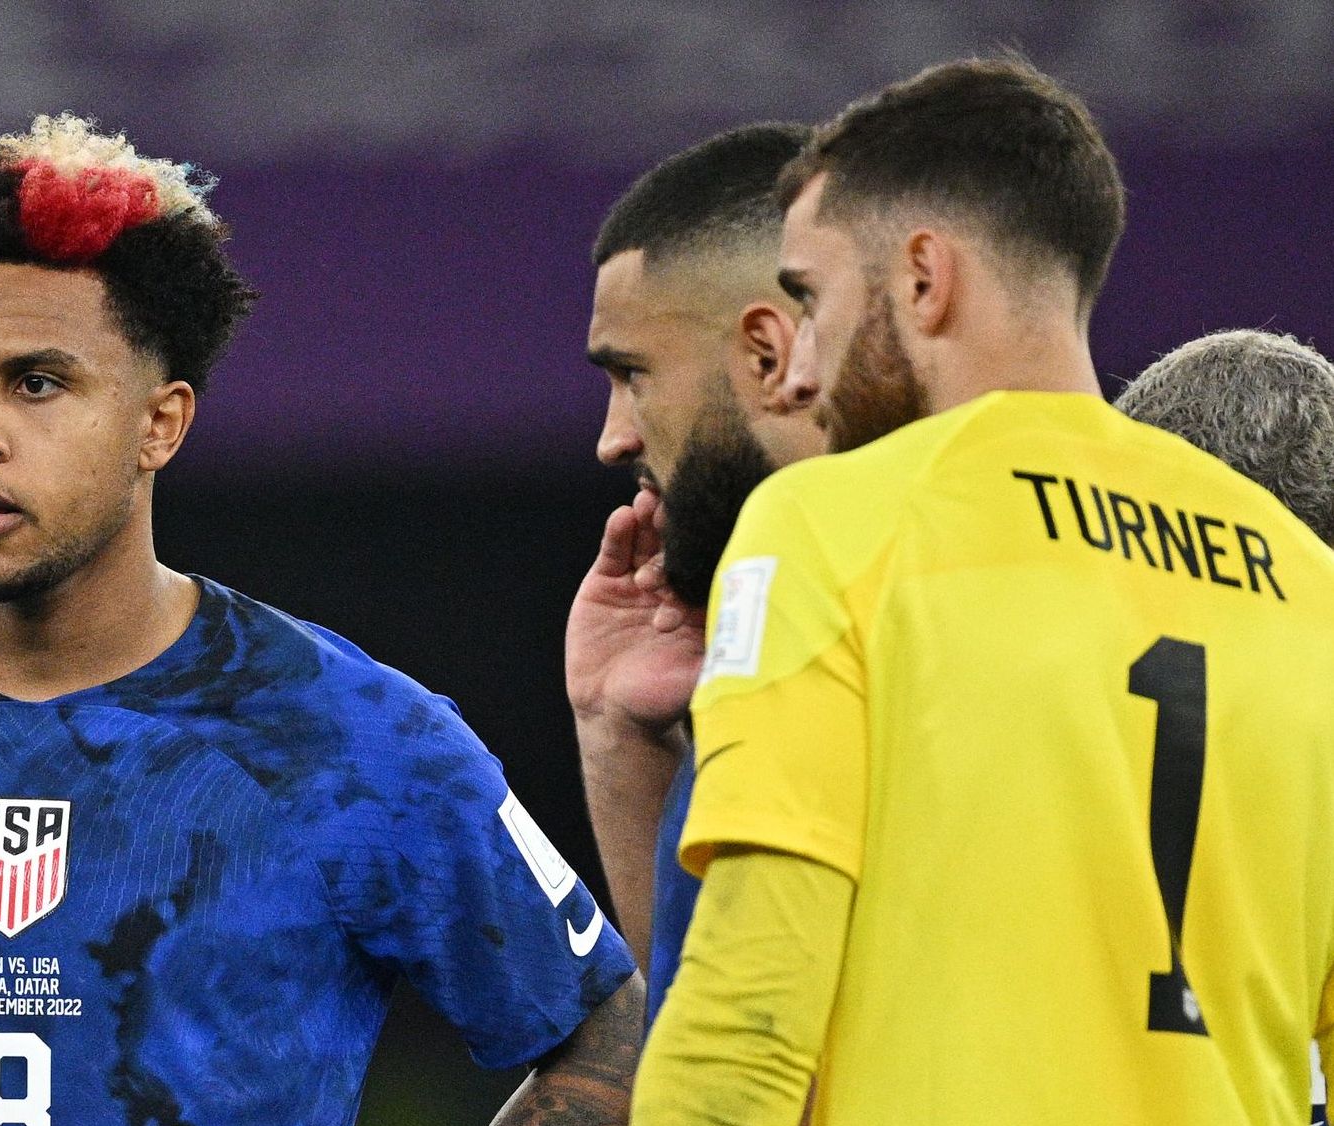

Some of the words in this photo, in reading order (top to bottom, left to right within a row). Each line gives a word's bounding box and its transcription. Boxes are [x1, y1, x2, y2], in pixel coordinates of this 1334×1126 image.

[1013, 469, 1286, 600] TURNER
[1128, 636, 1209, 1037] 1
[8, 957, 29, 974] VS.
[32, 957, 60, 975] USA
[15, 977, 60, 995] QATAR
[47, 998, 82, 1016] 2022
